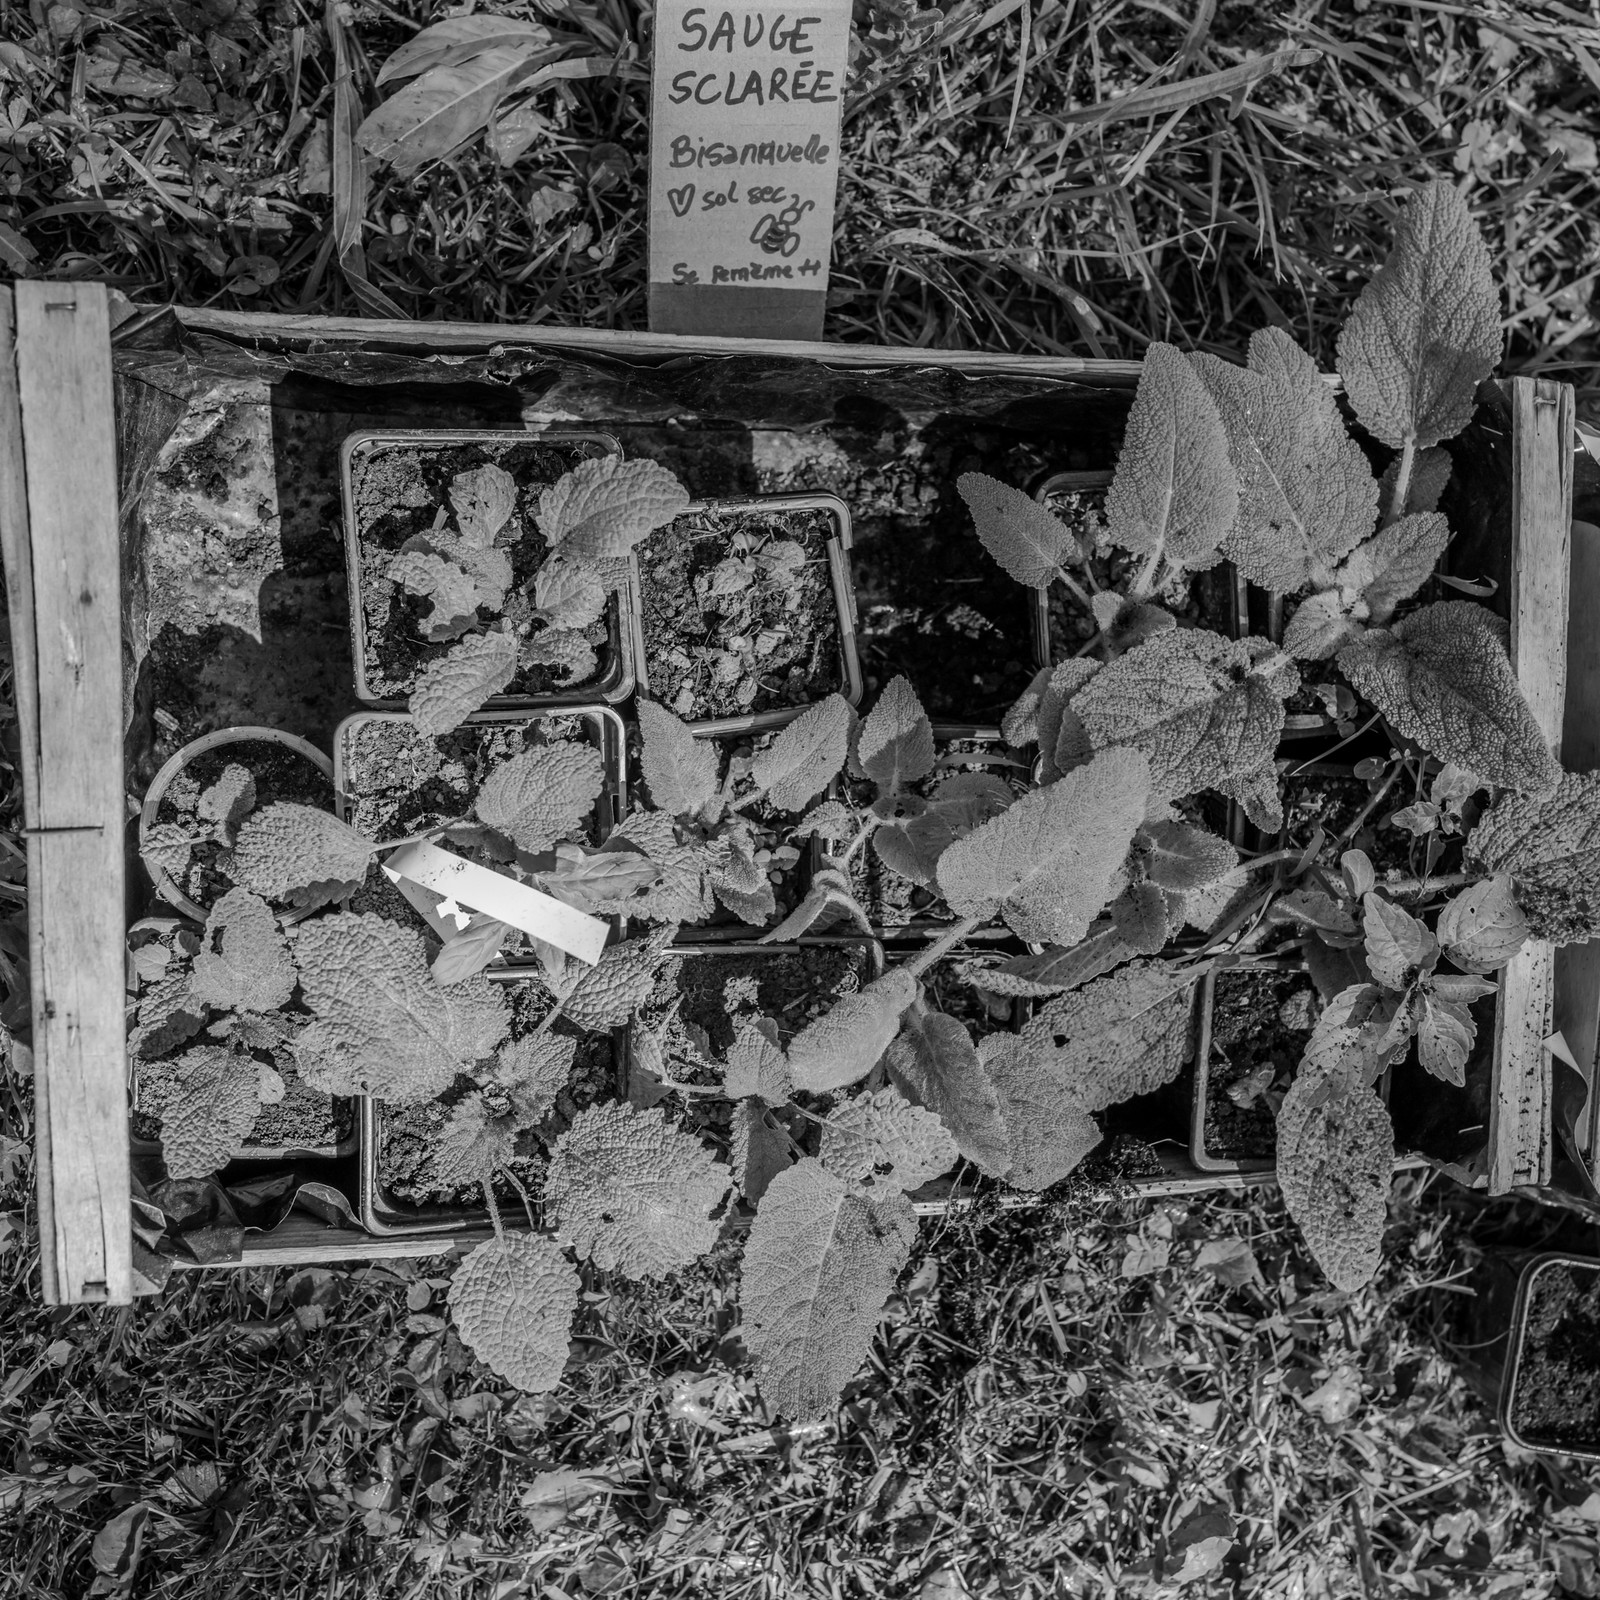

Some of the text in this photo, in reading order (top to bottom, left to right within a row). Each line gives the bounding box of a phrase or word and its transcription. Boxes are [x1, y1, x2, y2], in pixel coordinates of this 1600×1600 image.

[677, 7, 822, 54] SAUGE
[668, 60, 838, 106] SCLARÉE
[701, 180, 787, 211] sol sec
[671, 262, 700, 285] Se
